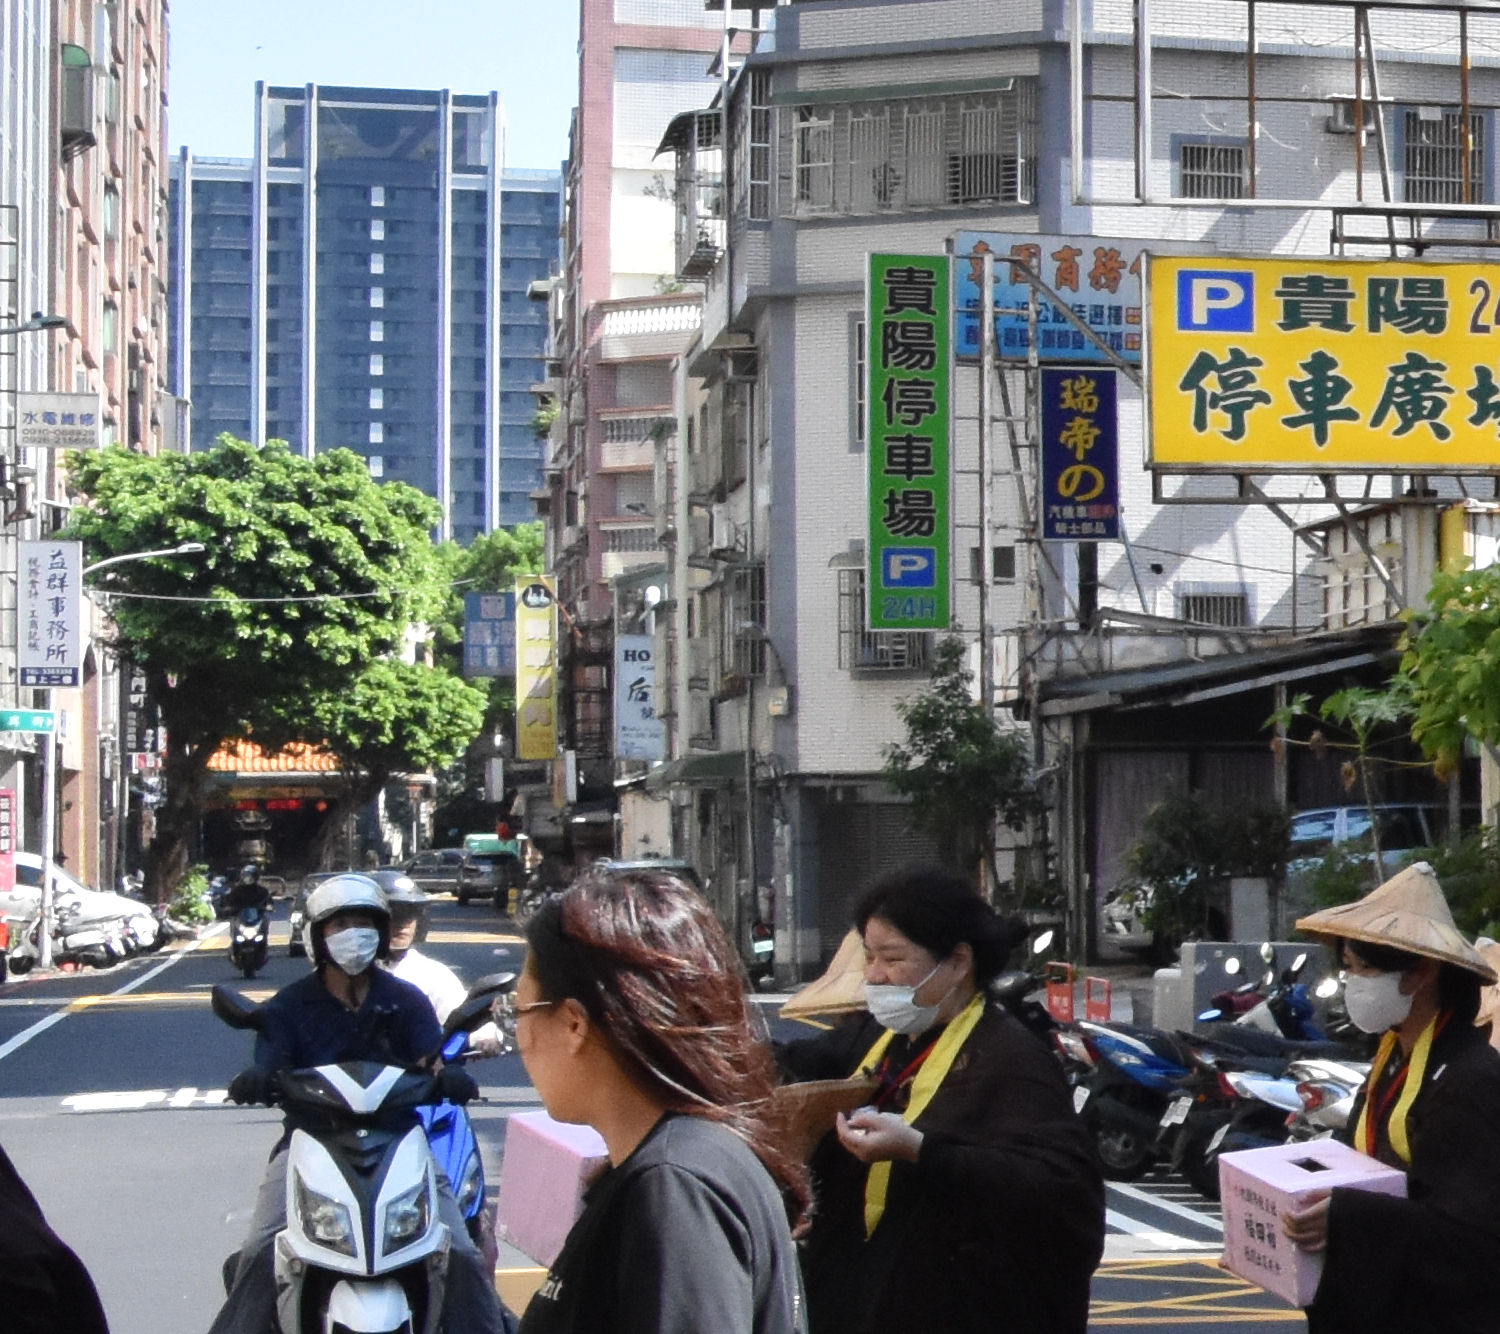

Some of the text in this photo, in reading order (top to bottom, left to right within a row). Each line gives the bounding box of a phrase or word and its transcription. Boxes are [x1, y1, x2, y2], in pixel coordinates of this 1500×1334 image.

[1192, 278, 1245, 324] P
[1275, 274, 1451, 335] 貴陽
[881, 265, 938, 539] 貴陽停車場
[889, 554, 929, 580] P
[45, 549, 69, 664] 益群事務所
[882, 596, 936, 620] 24H
